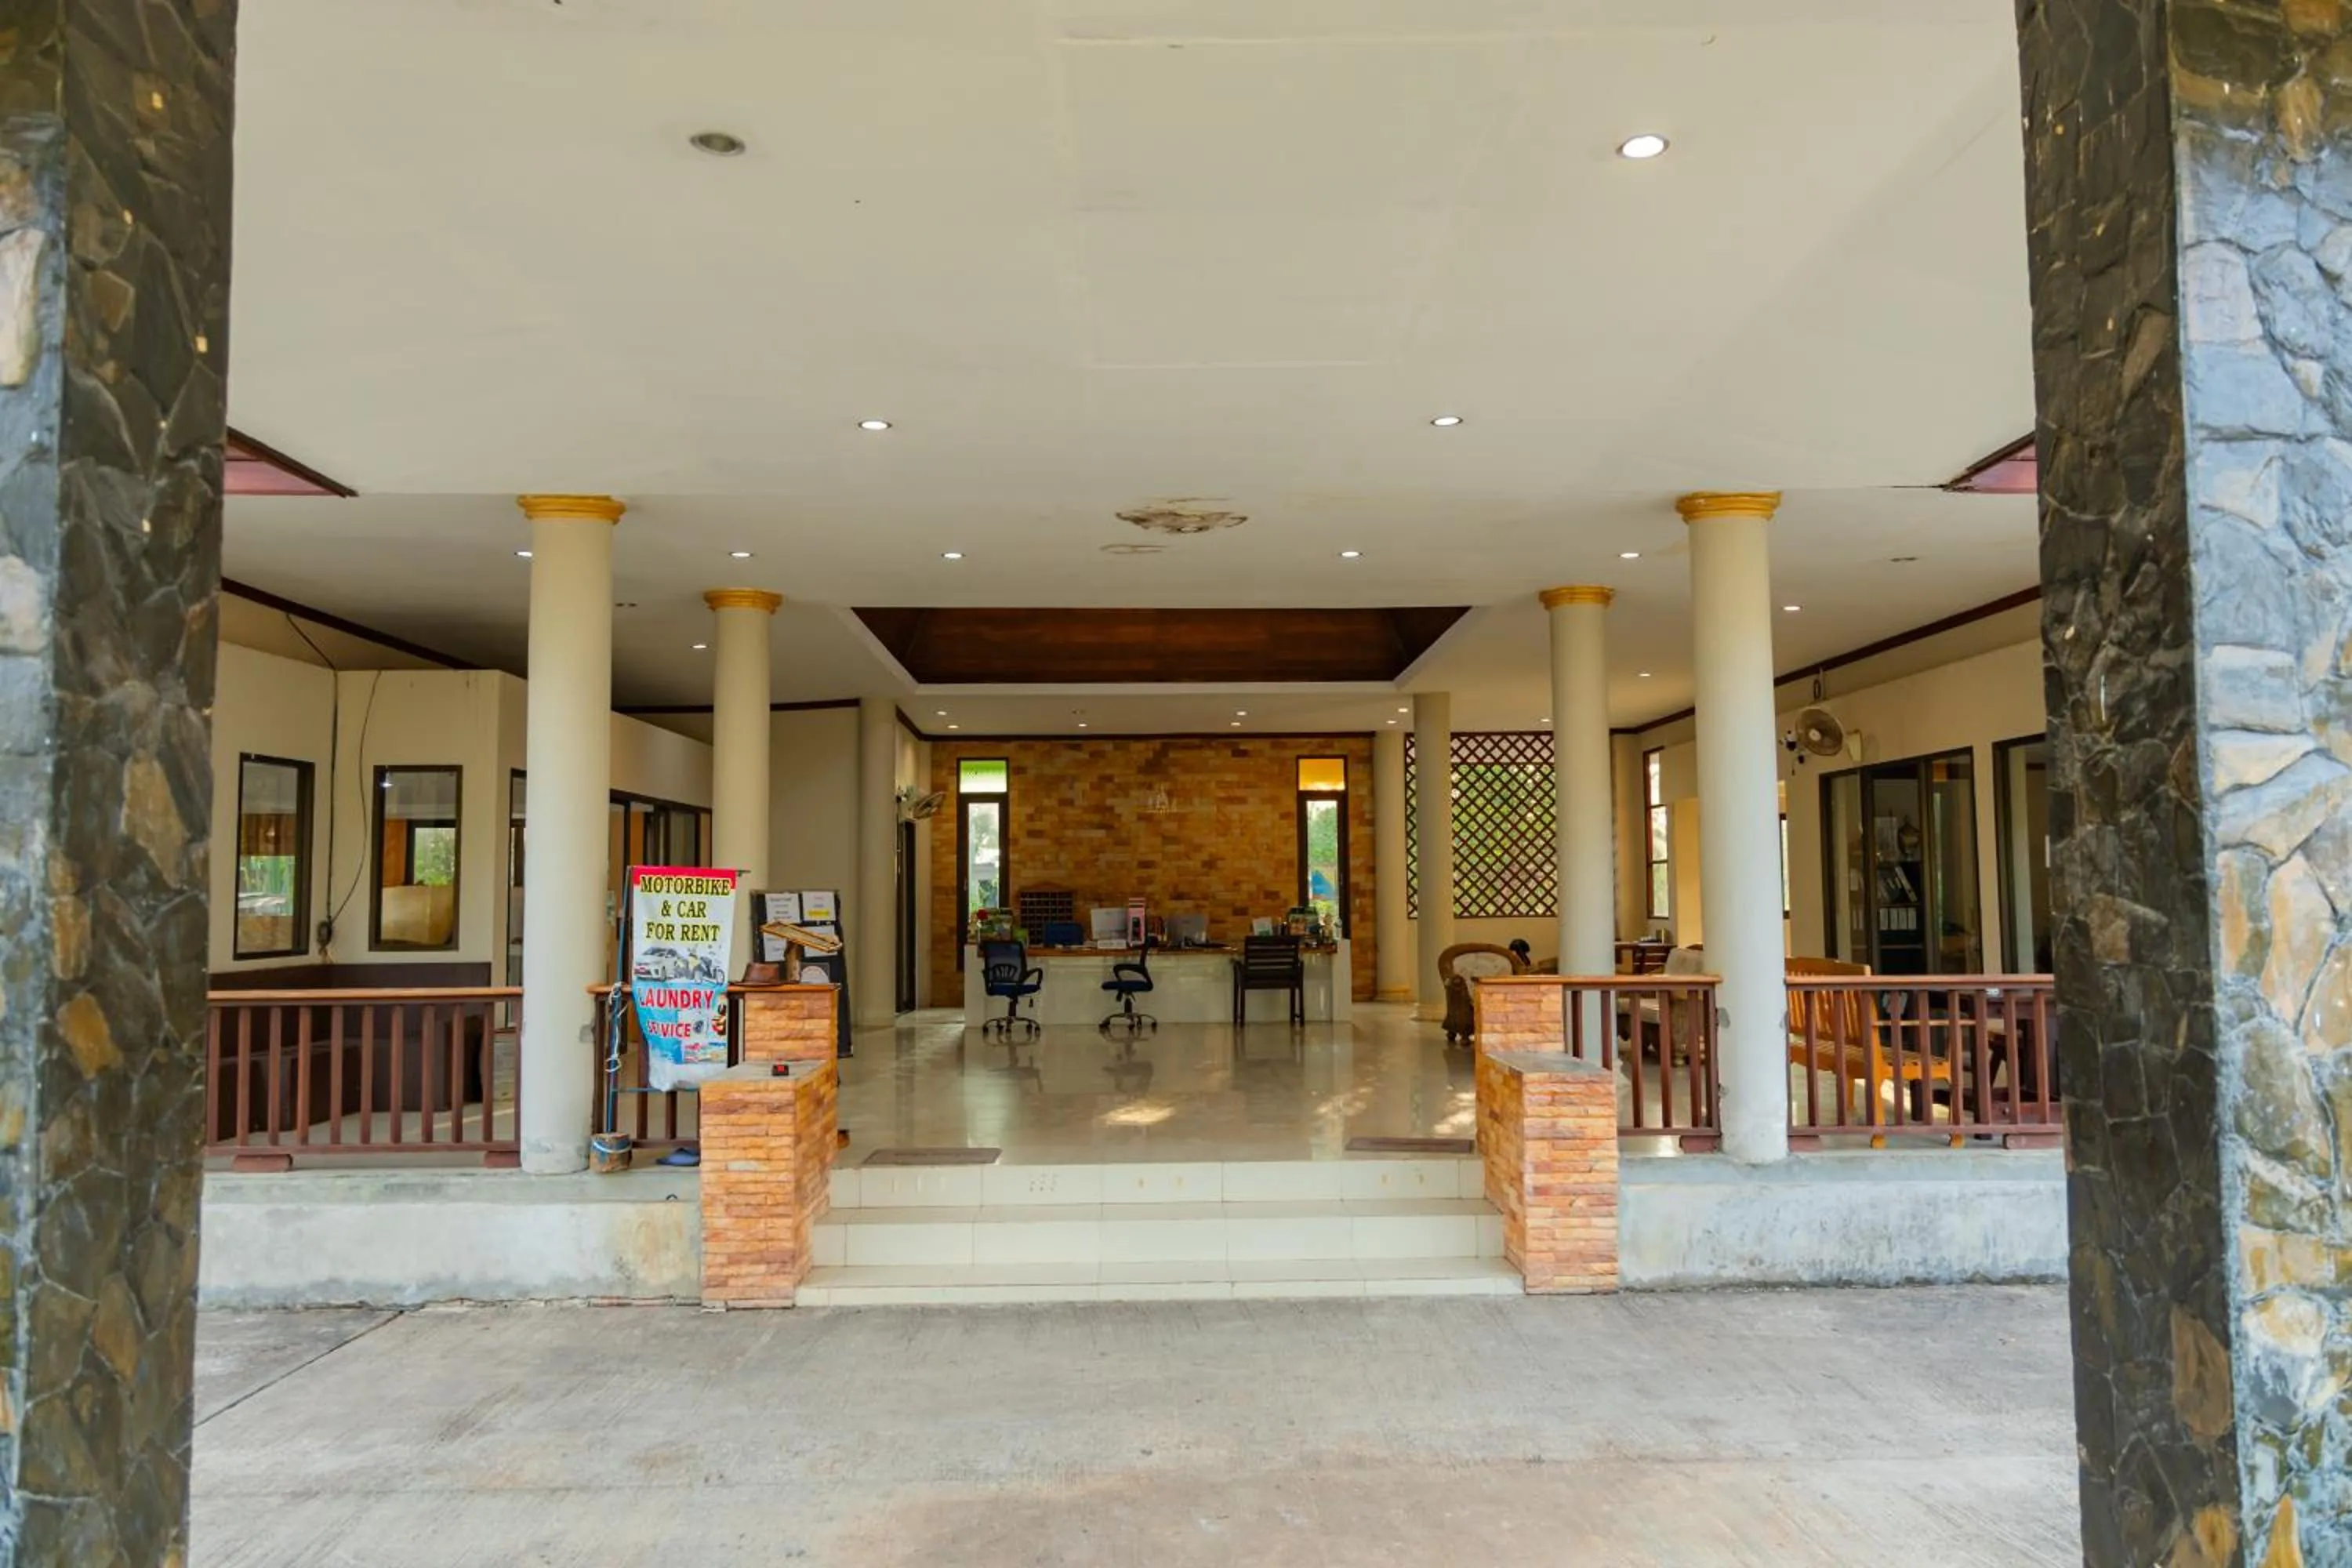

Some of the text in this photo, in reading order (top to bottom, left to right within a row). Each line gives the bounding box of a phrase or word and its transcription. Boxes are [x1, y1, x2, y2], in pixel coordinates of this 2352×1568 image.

[640, 876, 730, 895] MOTORBIKE
[661, 899, 706, 918] & CAR
[645, 922, 720, 942] FOR RENT
[648, 1020, 691, 1038] SVICE
